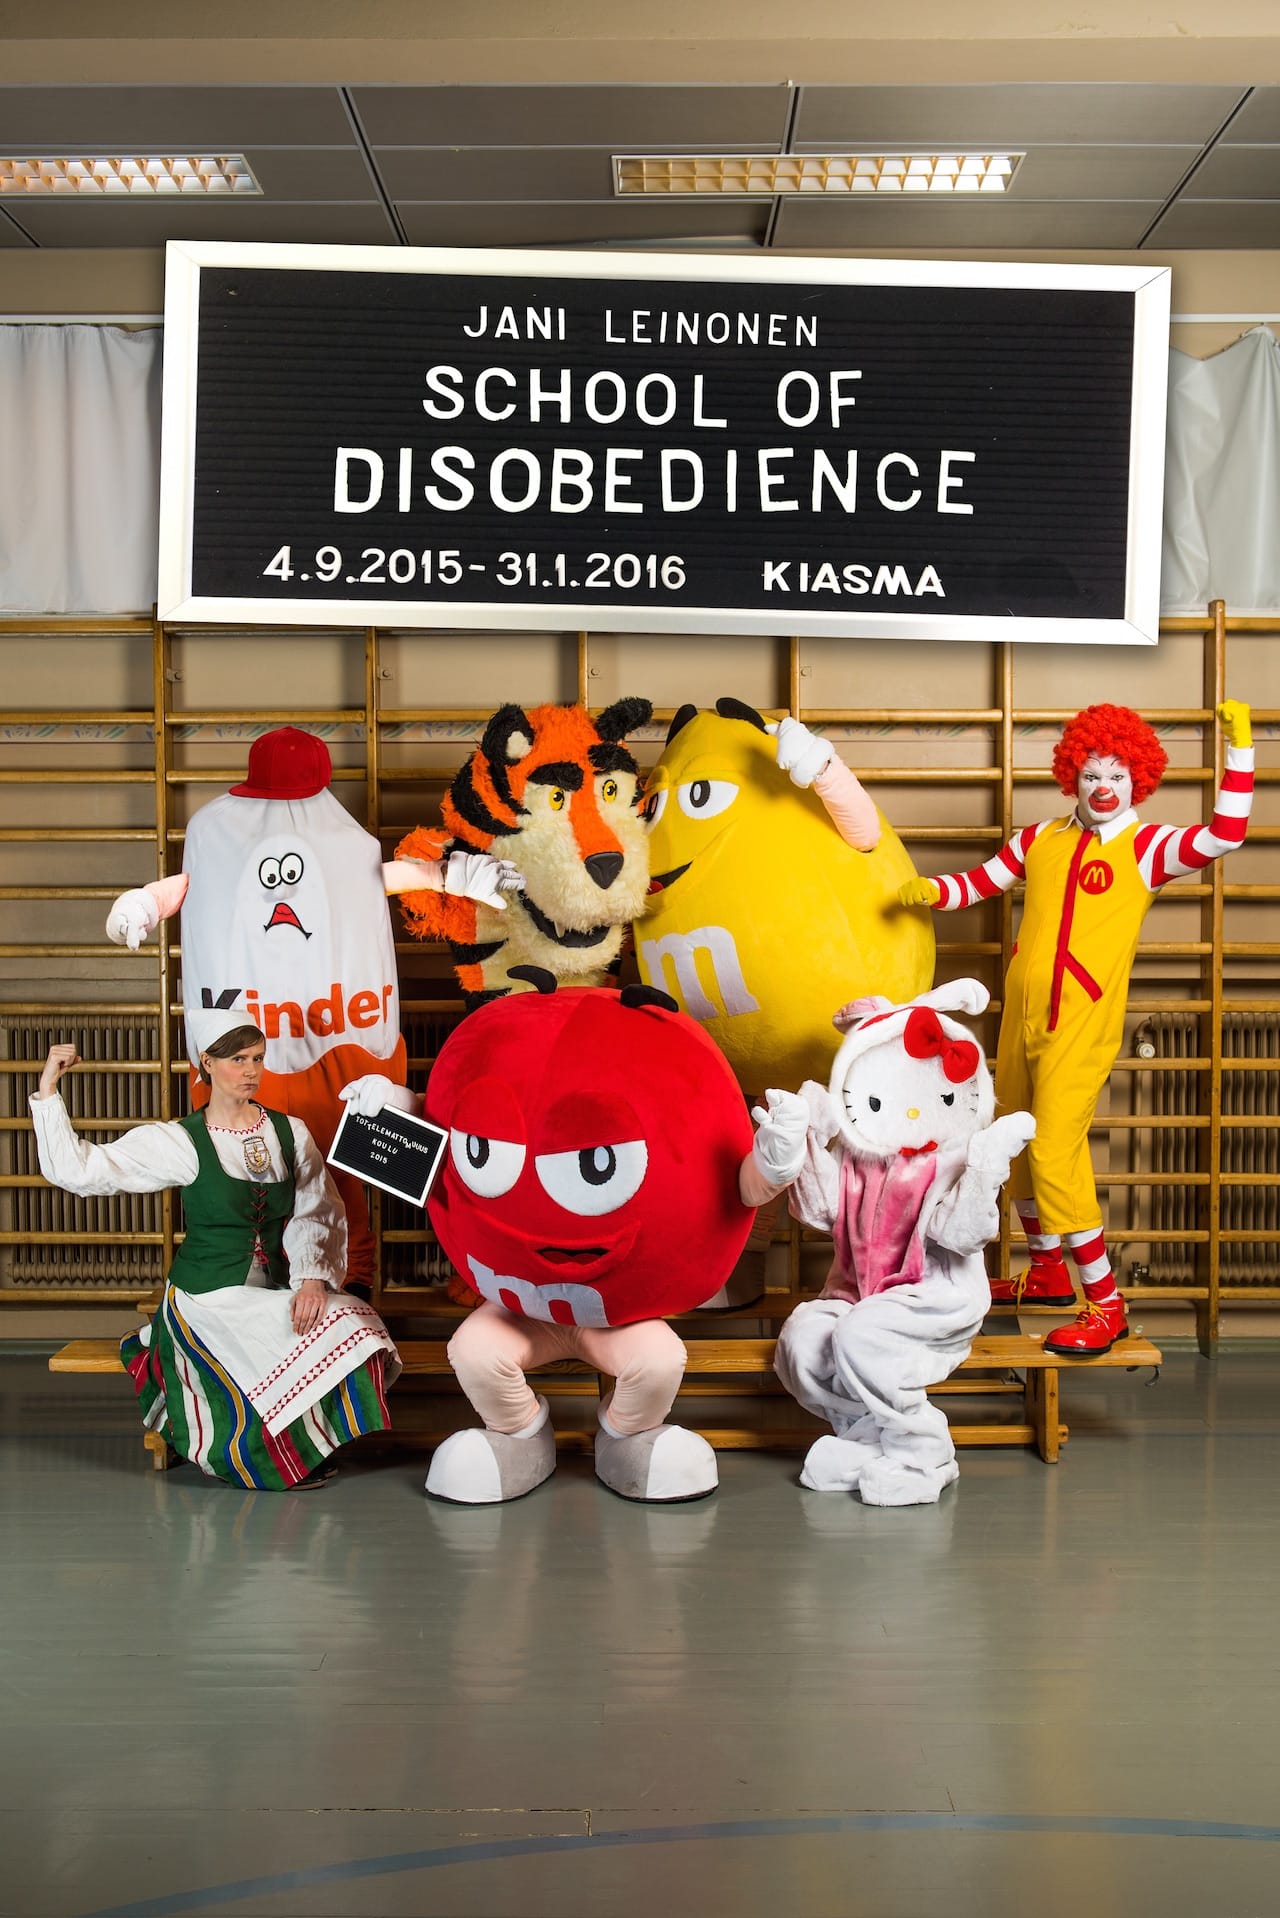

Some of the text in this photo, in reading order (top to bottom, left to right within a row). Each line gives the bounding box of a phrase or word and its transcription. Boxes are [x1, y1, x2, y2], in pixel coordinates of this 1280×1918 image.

[463, 305, 818, 348] JANI LEINONEN
[422, 365, 864, 429] SCHOOL OF
[333, 445, 977, 515] DISOBEDIENCE
[761, 560, 946, 598] KIASMA
[370, 1152, 388, 1164] 2015
[372, 1138, 398, 1154] KOULU
